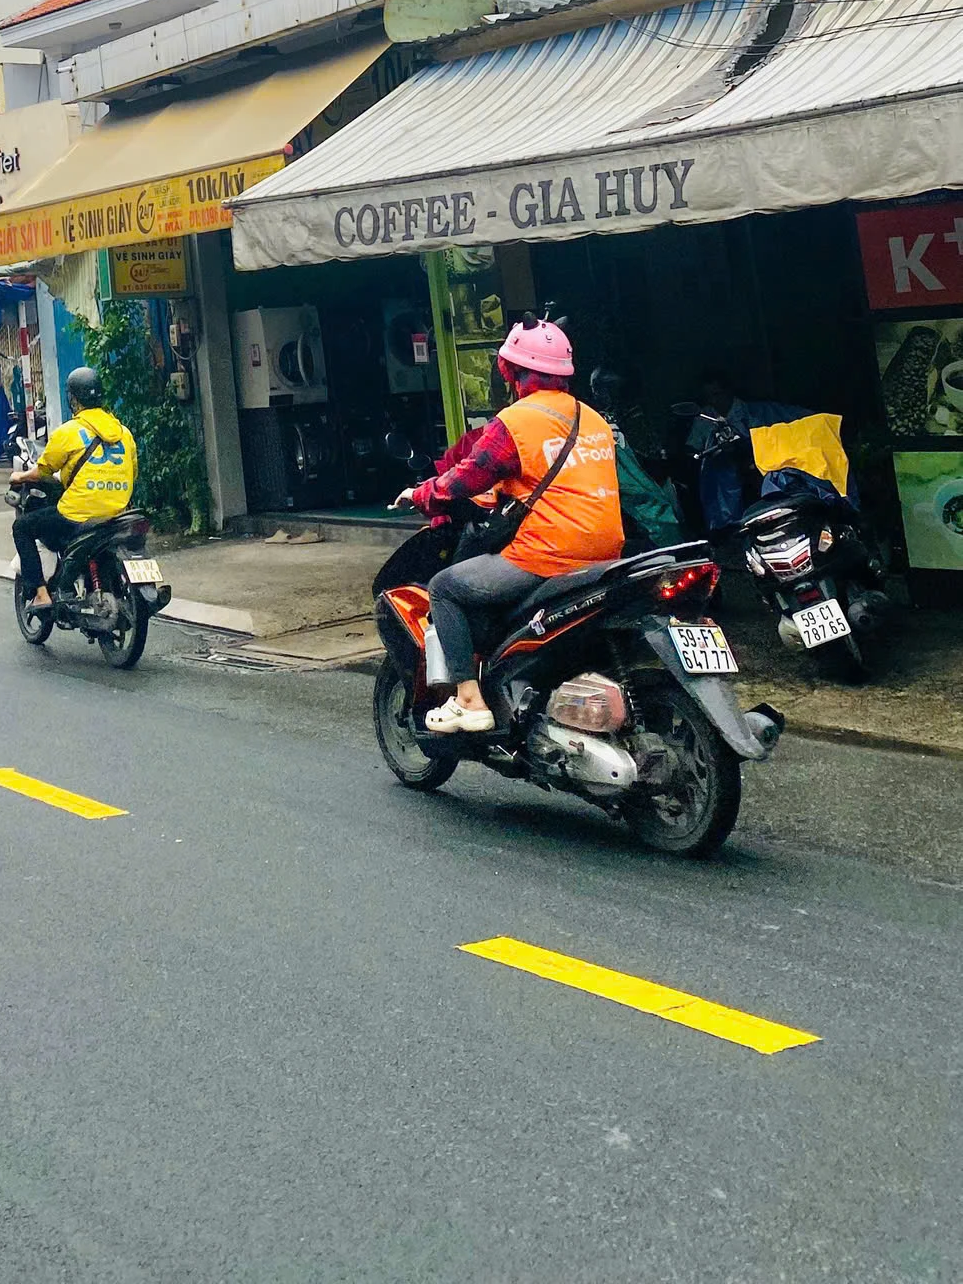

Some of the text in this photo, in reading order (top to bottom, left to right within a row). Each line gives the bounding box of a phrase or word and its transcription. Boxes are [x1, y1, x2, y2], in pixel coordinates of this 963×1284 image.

[334, 191, 476, 248] COFFEE
[509, 177, 585, 229] GIA
[595, 158, 695, 219] HUY
[20, 217, 39, 253] SẤY
[78, 207, 104, 241] SINH
[106, 198, 132, 235] GIÀY
[116, 250, 129, 263] VỆ
[131, 251, 156, 261] SINH
[576, 443, 614, 464] Food
[682, 650, 731, 670] 647.77
